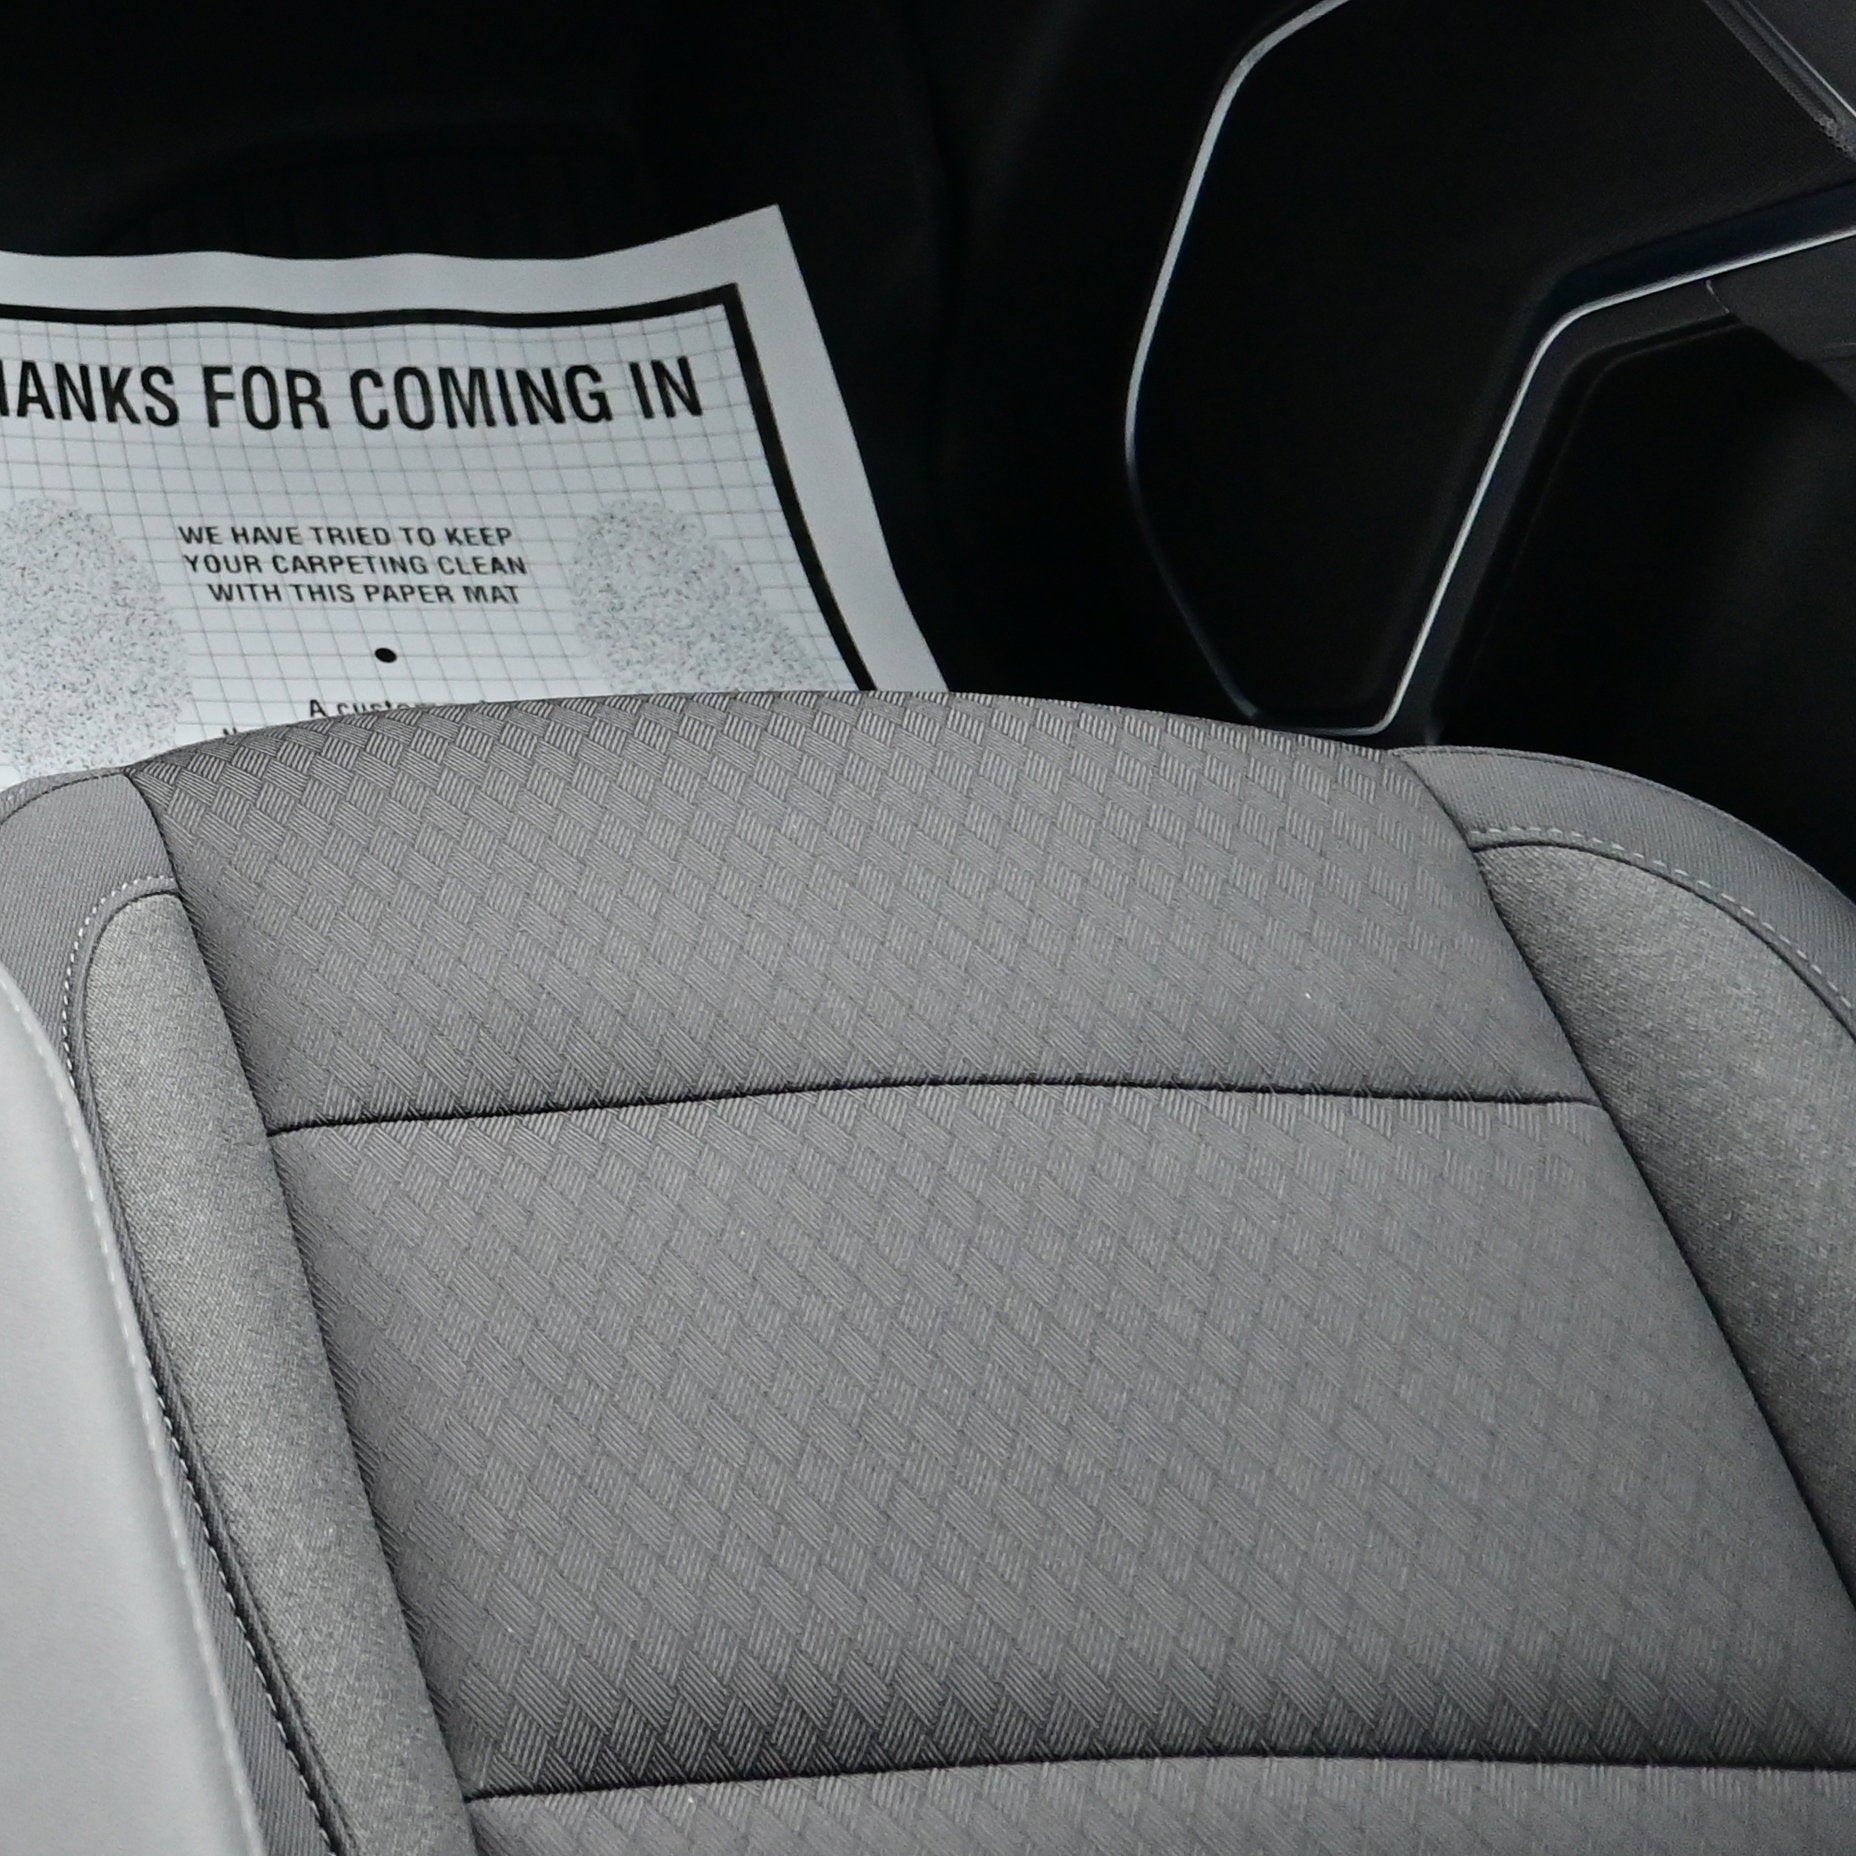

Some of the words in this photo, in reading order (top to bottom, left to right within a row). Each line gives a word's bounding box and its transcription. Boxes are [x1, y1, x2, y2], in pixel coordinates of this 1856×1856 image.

[204, 366, 330, 431] FOR
[350, 363, 614, 431] COMING
[633, 355, 704, 419] IN
[178, 526, 224, 546] WE
[231, 526, 302, 546] HAVE
[309, 526, 390, 546] TRIED
[399, 526, 437, 546] TO
[445, 527, 513, 546] KEEP
[183, 554, 263, 575] YOUR
[272, 554, 428, 576] CARPETING
[437, 555, 528, 576] CLEAN
[207, 584, 282, 603] WITH
[289, 584, 355, 604] THIS
[364, 584, 454, 604] PAPER
[463, 584, 520, 604] MAT
[309, 699, 327, 718] A
